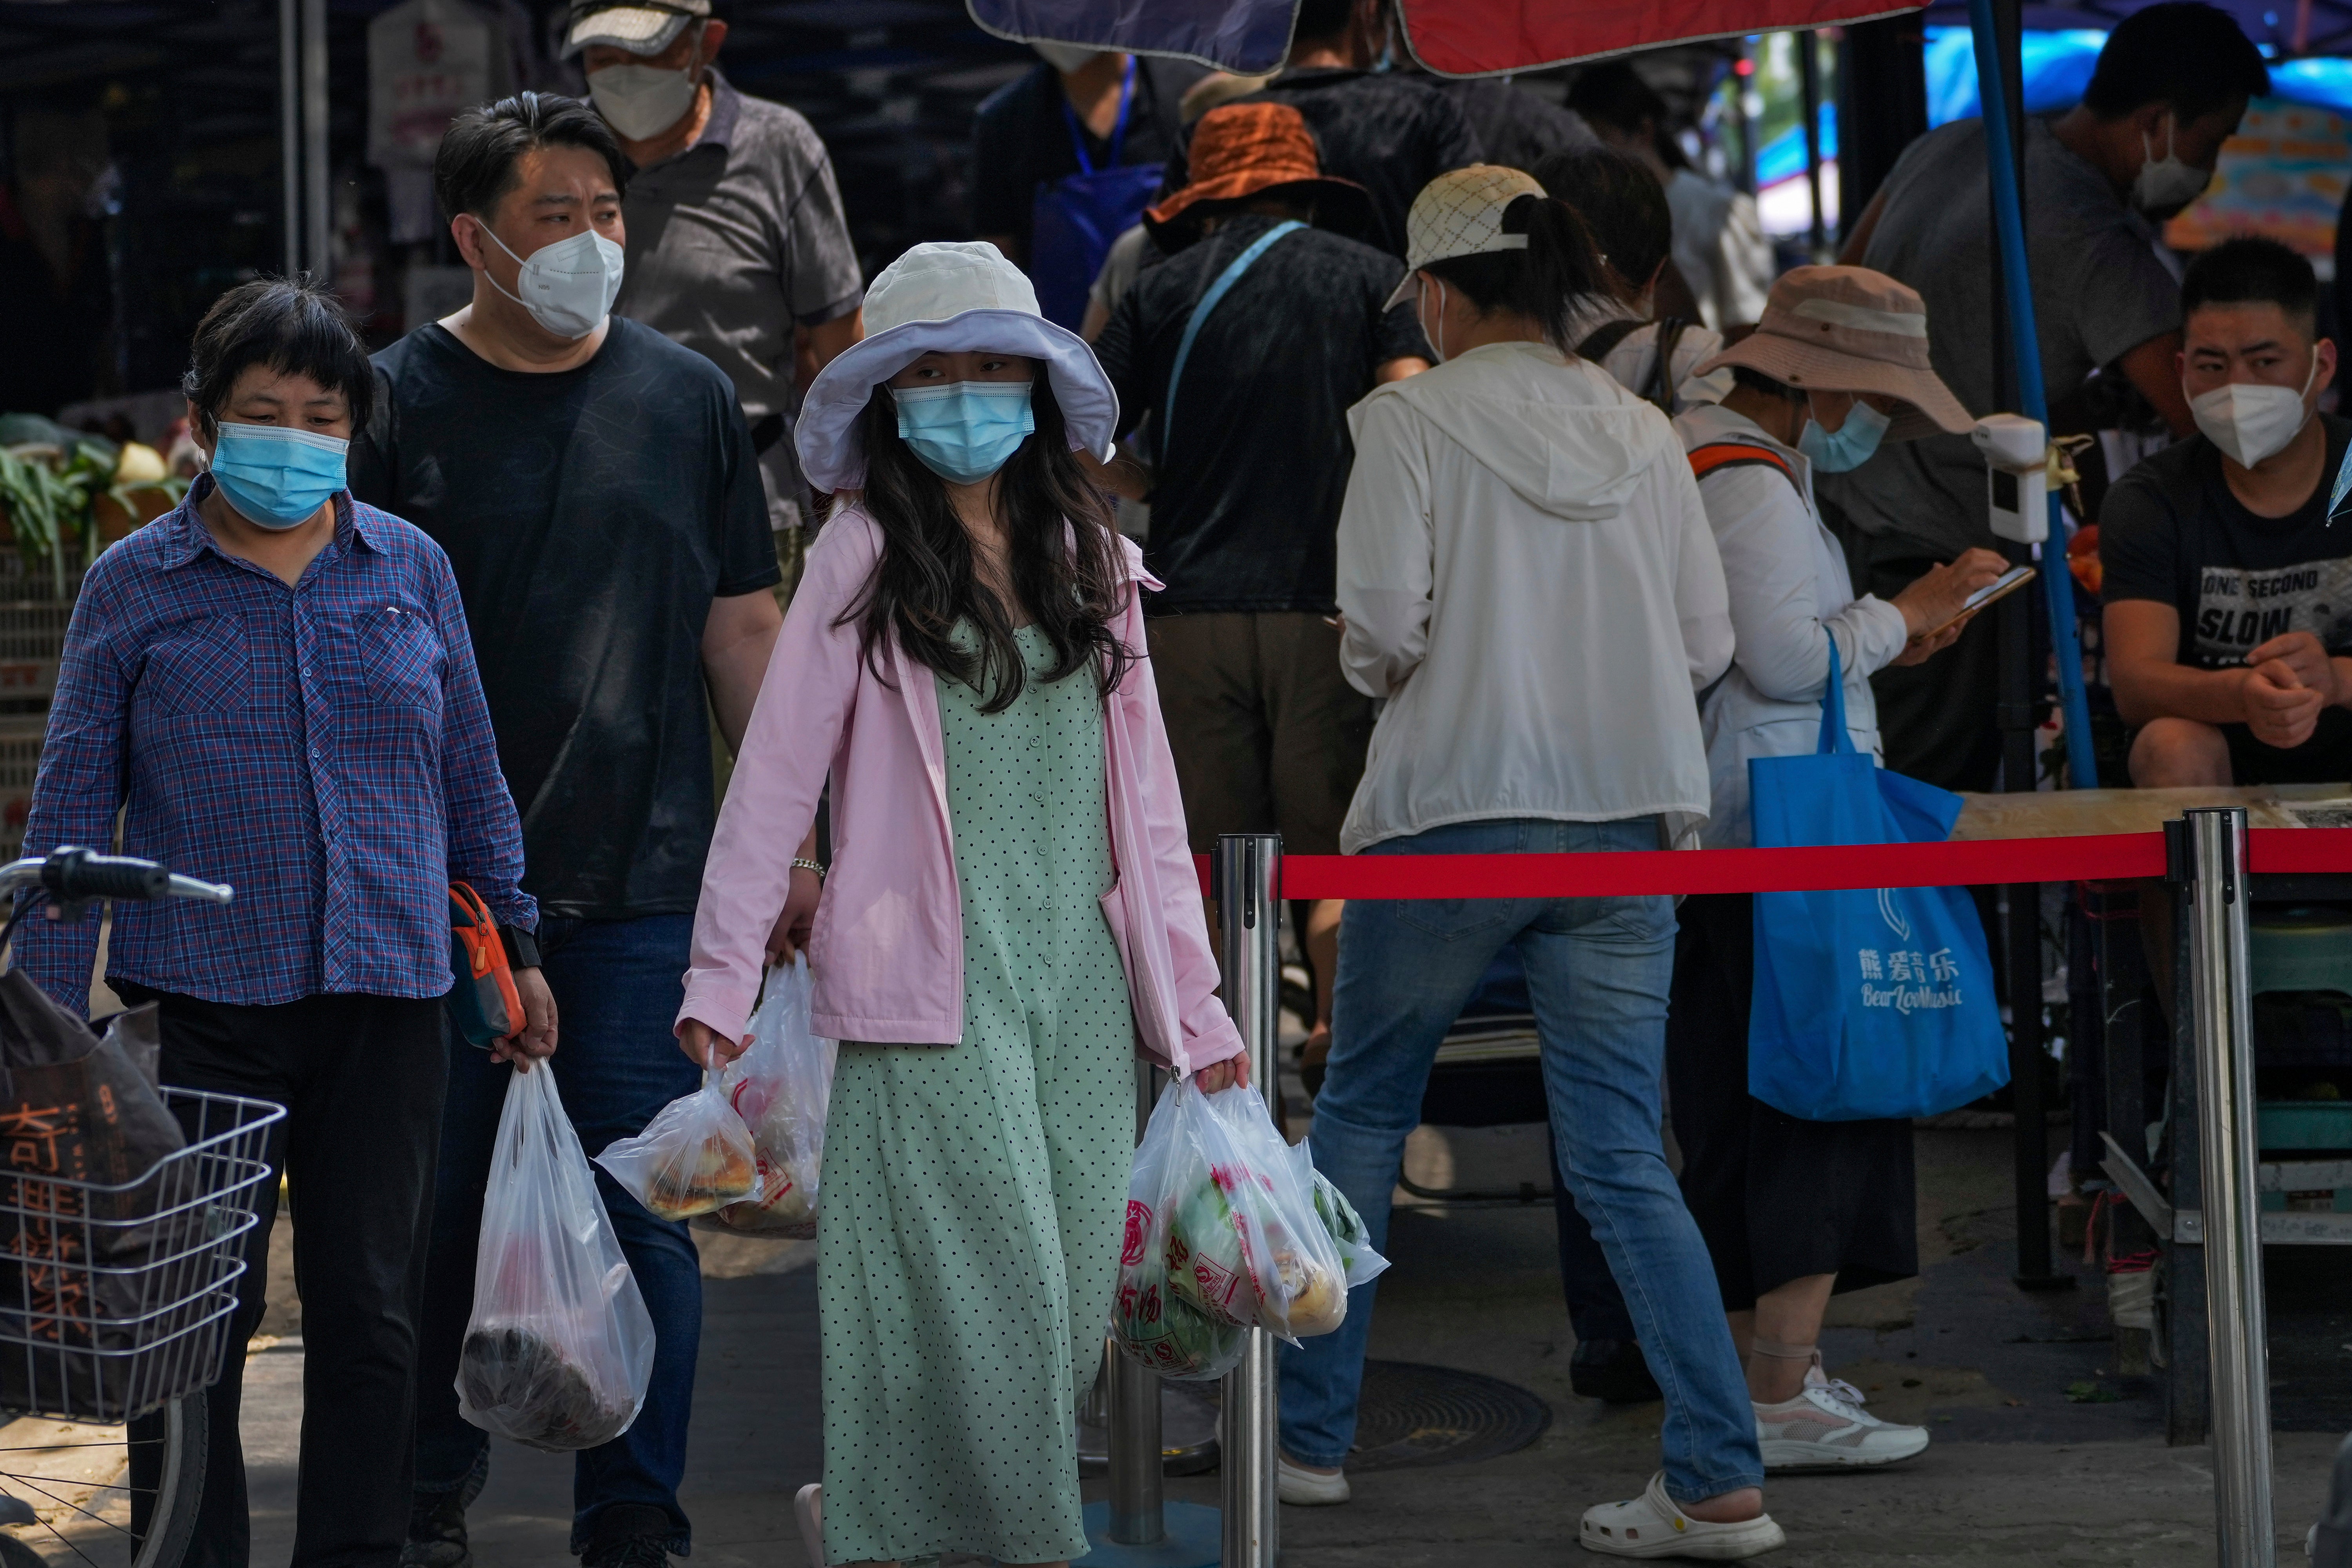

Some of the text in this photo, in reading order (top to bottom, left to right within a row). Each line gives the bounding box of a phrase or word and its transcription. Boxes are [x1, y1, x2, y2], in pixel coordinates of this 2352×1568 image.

[2203, 570, 2318, 598] ONE SECOND
[2198, 607, 2292, 644] SLOW
[1858, 947, 1960, 983] 熊爱音乐
[1207, 1275, 1220, 1290] 生产许可
